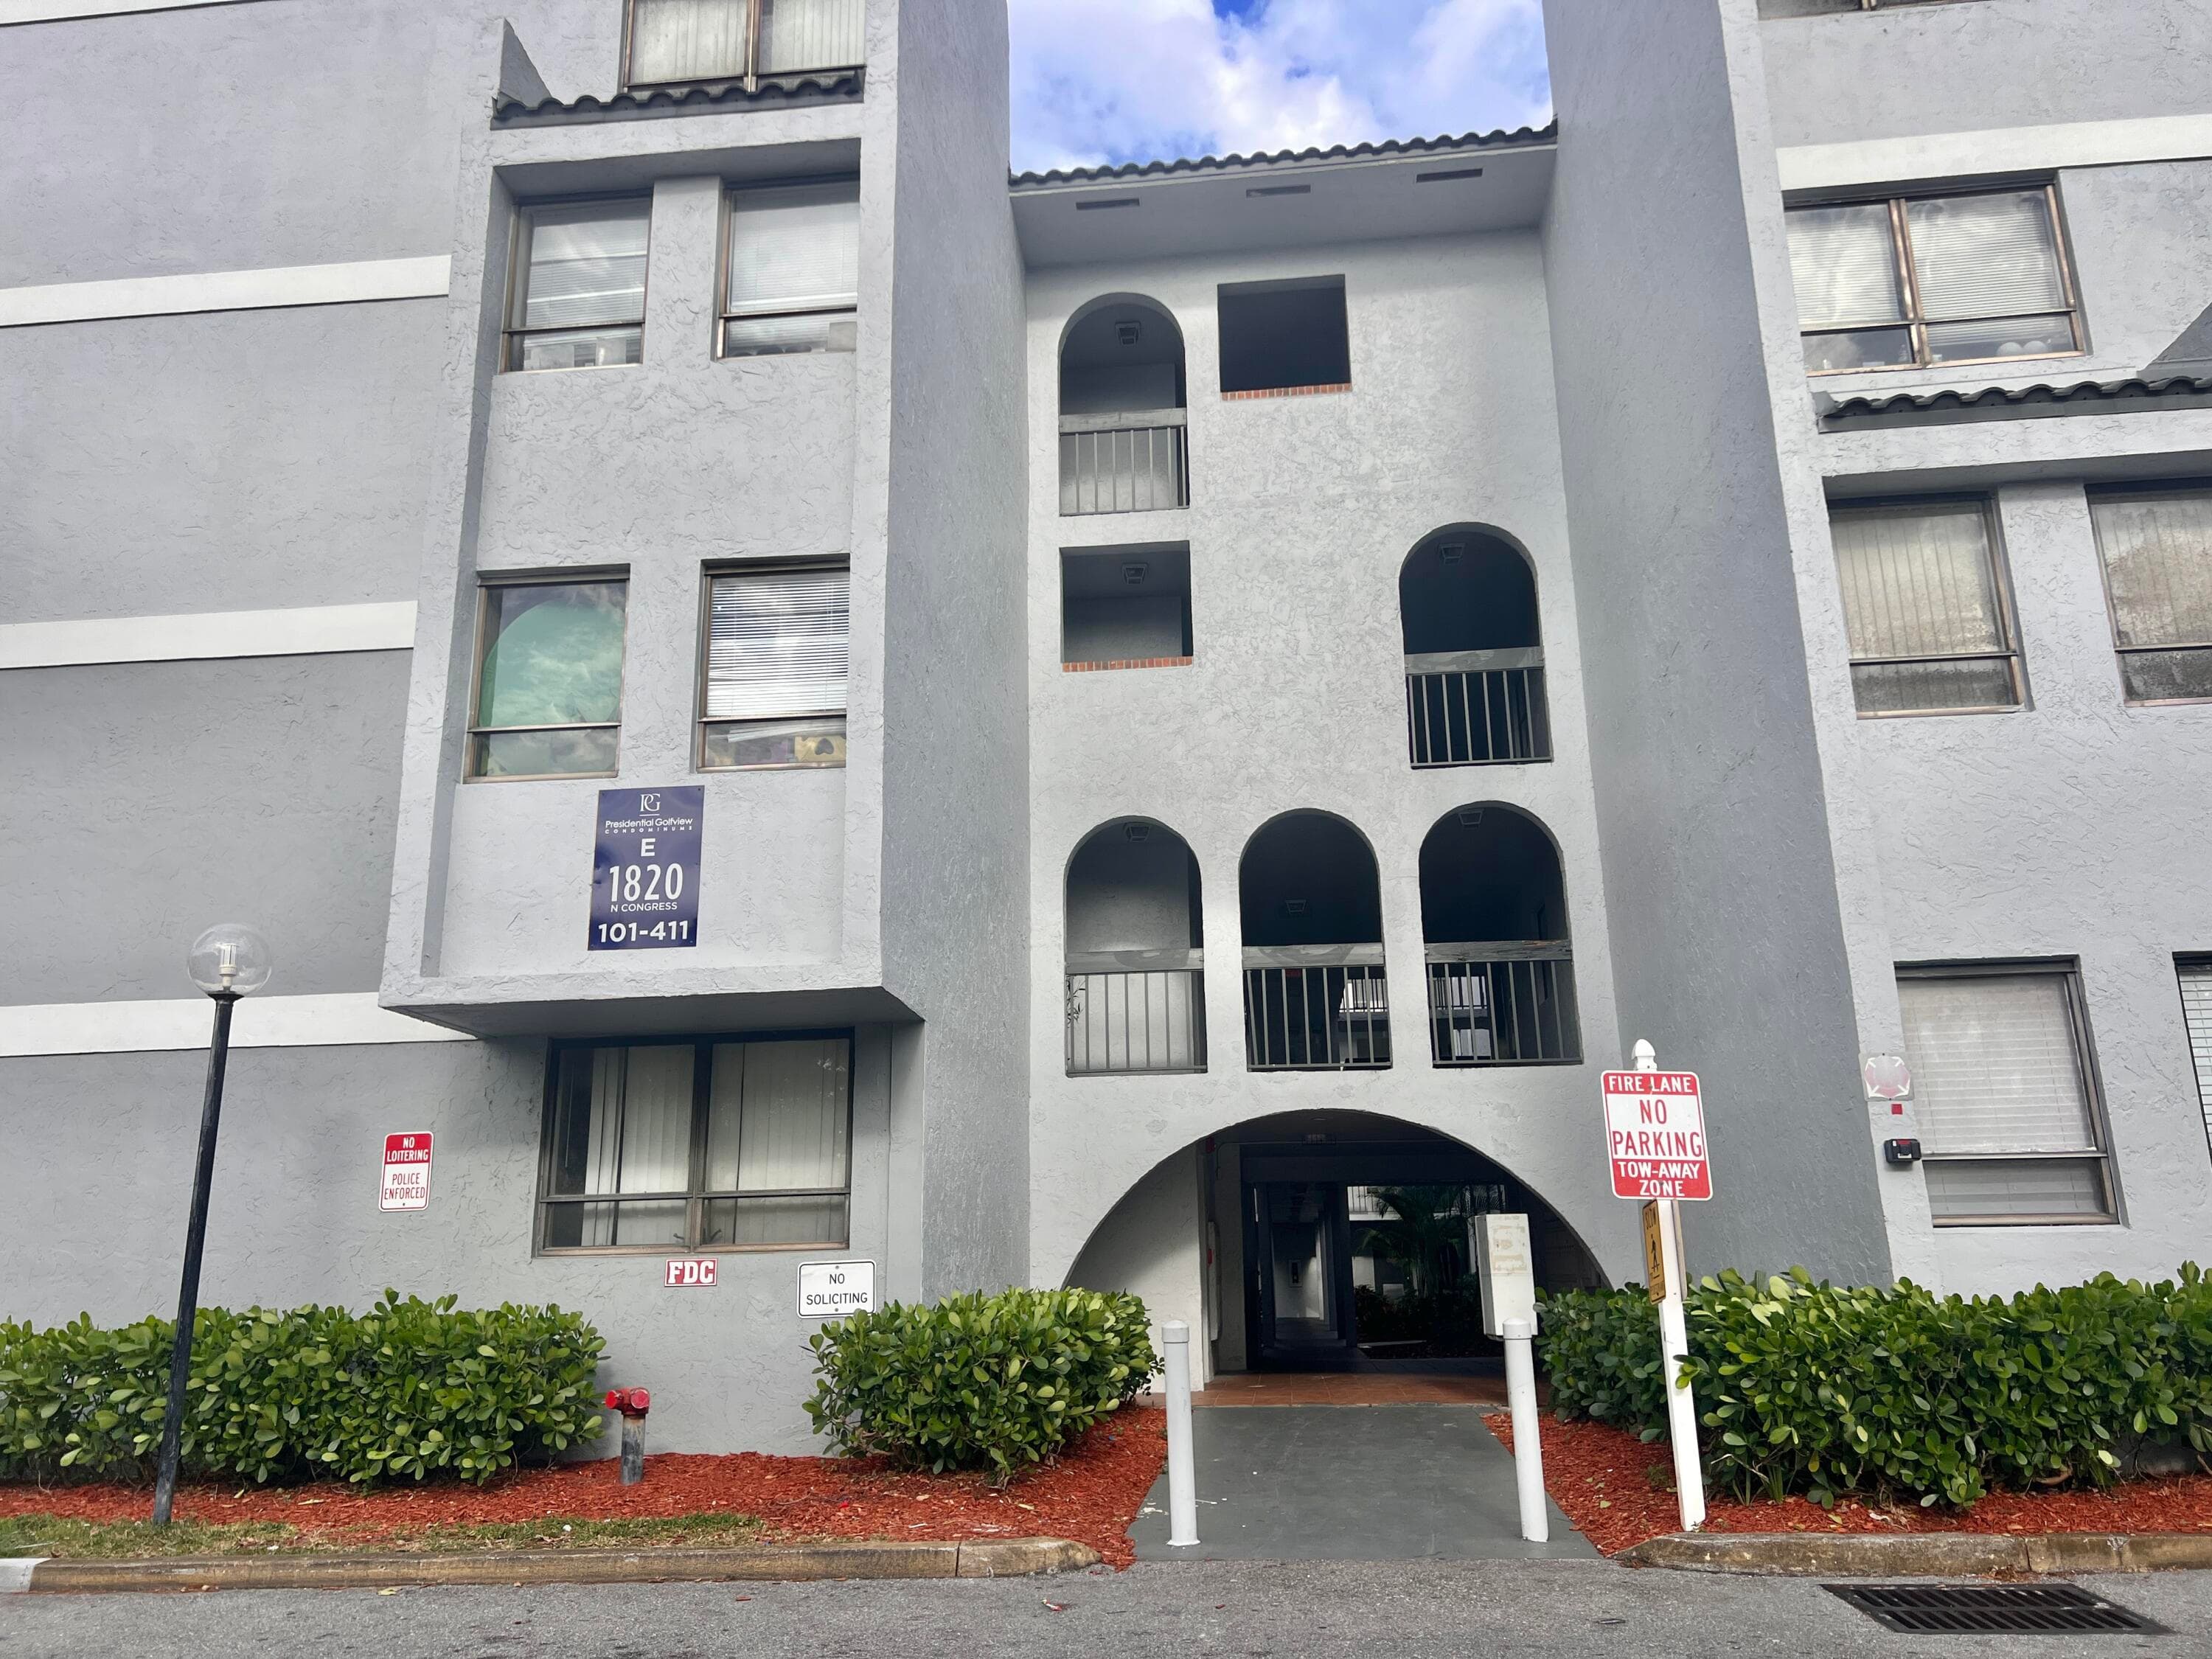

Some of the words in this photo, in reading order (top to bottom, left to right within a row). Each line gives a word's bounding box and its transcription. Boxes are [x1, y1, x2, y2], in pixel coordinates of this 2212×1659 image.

[605, 818, 654, 829] Presidential
[655, 816, 693, 827] Golfview
[641, 838, 656, 857] E
[609, 863, 684, 902] 1820
[611, 905, 618, 913] N
[621, 902, 678, 912] CONGRESS
[598, 920, 688, 943] 101-411
[1608, 1075, 1644, 1092] FIRE
[1650, 1077, 1693, 1093] LANE
[1639, 1099, 1667, 1124] NO
[403, 1136, 415, 1149] NO
[1612, 1130, 1703, 1158] PARKING
[386, 1149, 429, 1162] LOITERING
[392, 1172, 421, 1186] POLICE
[1617, 1161, 1700, 1179] TOW-AWAY
[384, 1186, 425, 1200] ENFORCED
[1638, 1179, 1686, 1197] ZONE
[667, 1261, 714, 1284] FDC
[829, 1273, 845, 1284] NO
[806, 1292, 869, 1305] SOLICITING
